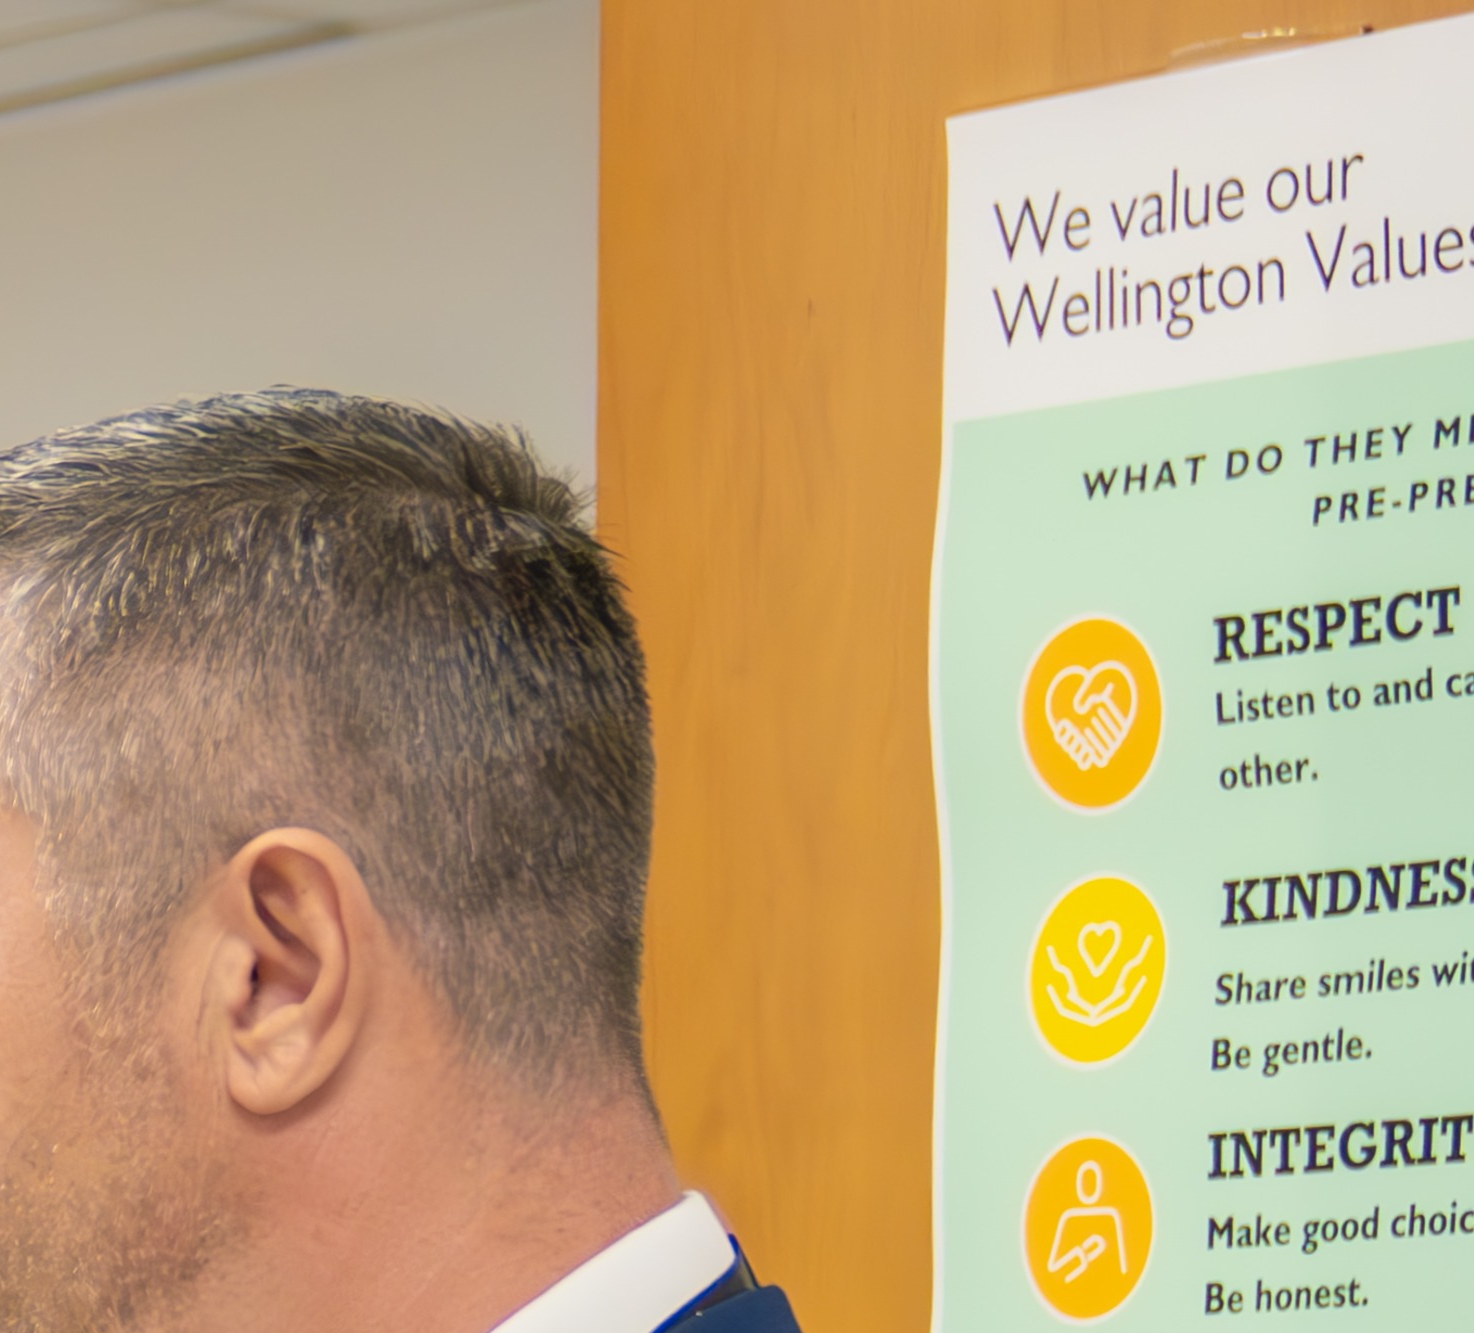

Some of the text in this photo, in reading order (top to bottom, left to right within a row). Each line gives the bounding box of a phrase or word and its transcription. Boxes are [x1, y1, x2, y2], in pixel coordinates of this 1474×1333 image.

[993, 151, 1365, 263] We value our
[992, 265, 1286, 349] Wellington
[1082, 453, 1207, 501] WHAT
[1225, 443, 1284, 481] DO
[1304, 422, 1413, 470] THEY
[1213, 583, 1462, 666] RESPECT
[1216, 688, 1316, 727] Listen
[1326, 681, 1362, 713] to
[1373, 666, 1434, 708] and
[1219, 752, 1319, 791] other.
[1220, 856, 1474, 929] KINDNES
[1214, 971, 1308, 1007] Share
[1317, 956, 1421, 998] smiles
[1211, 1026, 1373, 1079] Be gentle.
[1207, 1113, 1474, 1181] INTEGRIT
[1207, 1199, 1474, 1256] Make good choic
[1204, 1276, 1369, 1316] Be honest.
